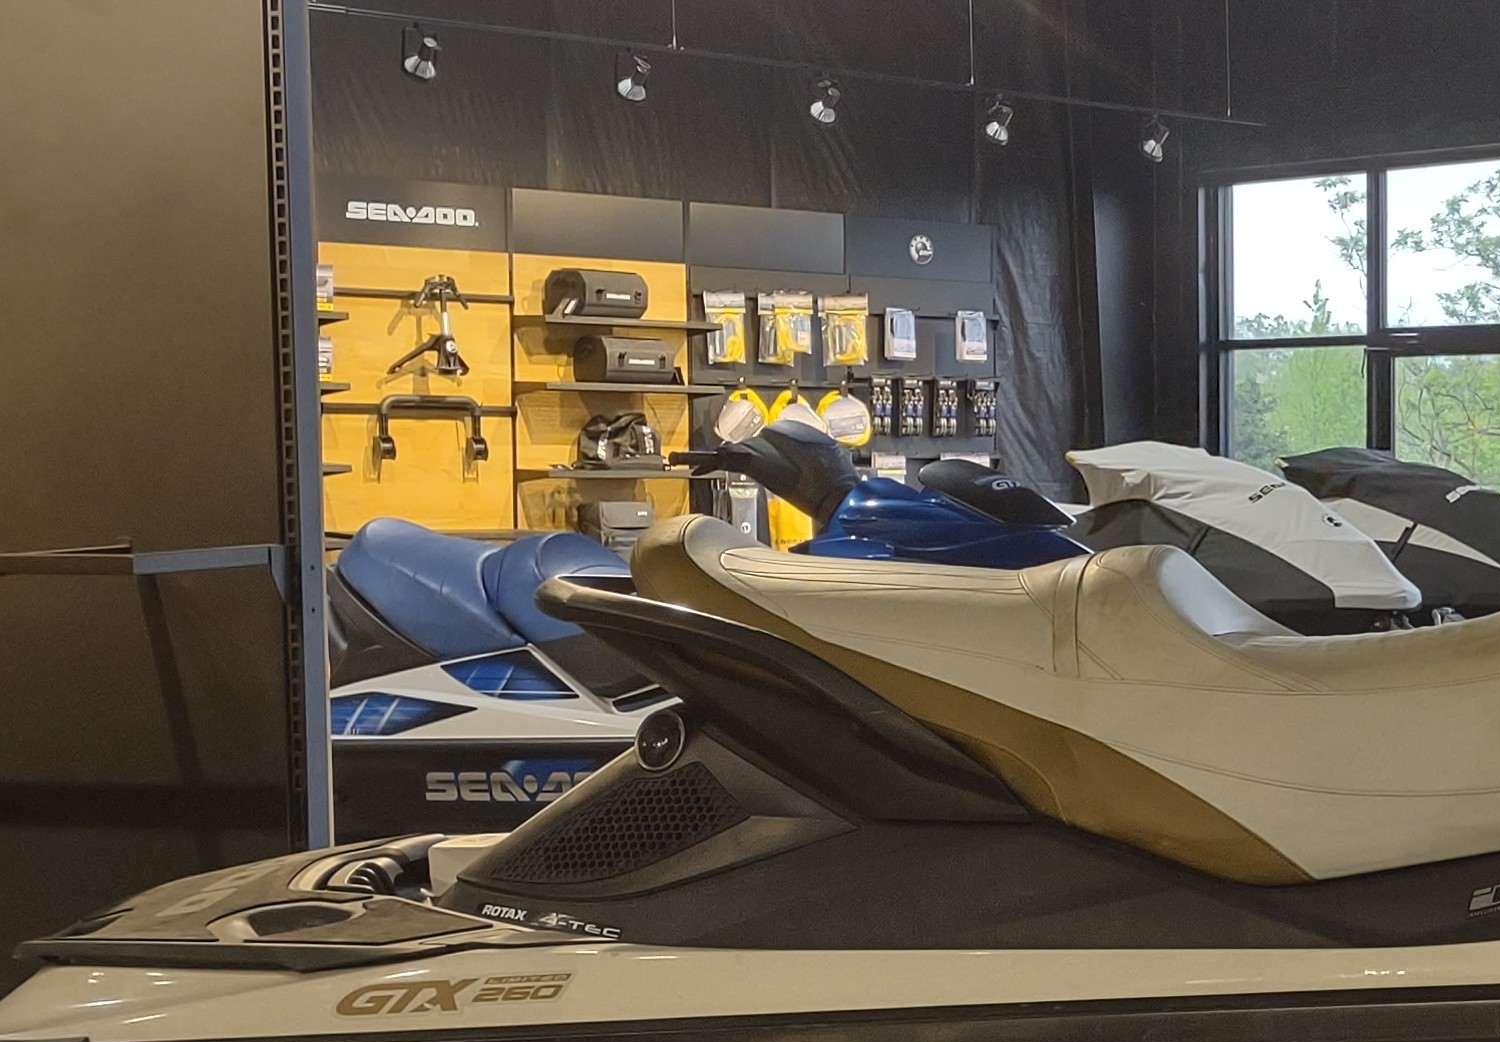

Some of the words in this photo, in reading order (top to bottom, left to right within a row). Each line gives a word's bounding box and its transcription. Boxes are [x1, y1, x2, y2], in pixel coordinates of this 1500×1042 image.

[481, 903, 528, 921] ROTAX
[335, 977, 481, 1016] GTX
[471, 984, 563, 1003] 260
